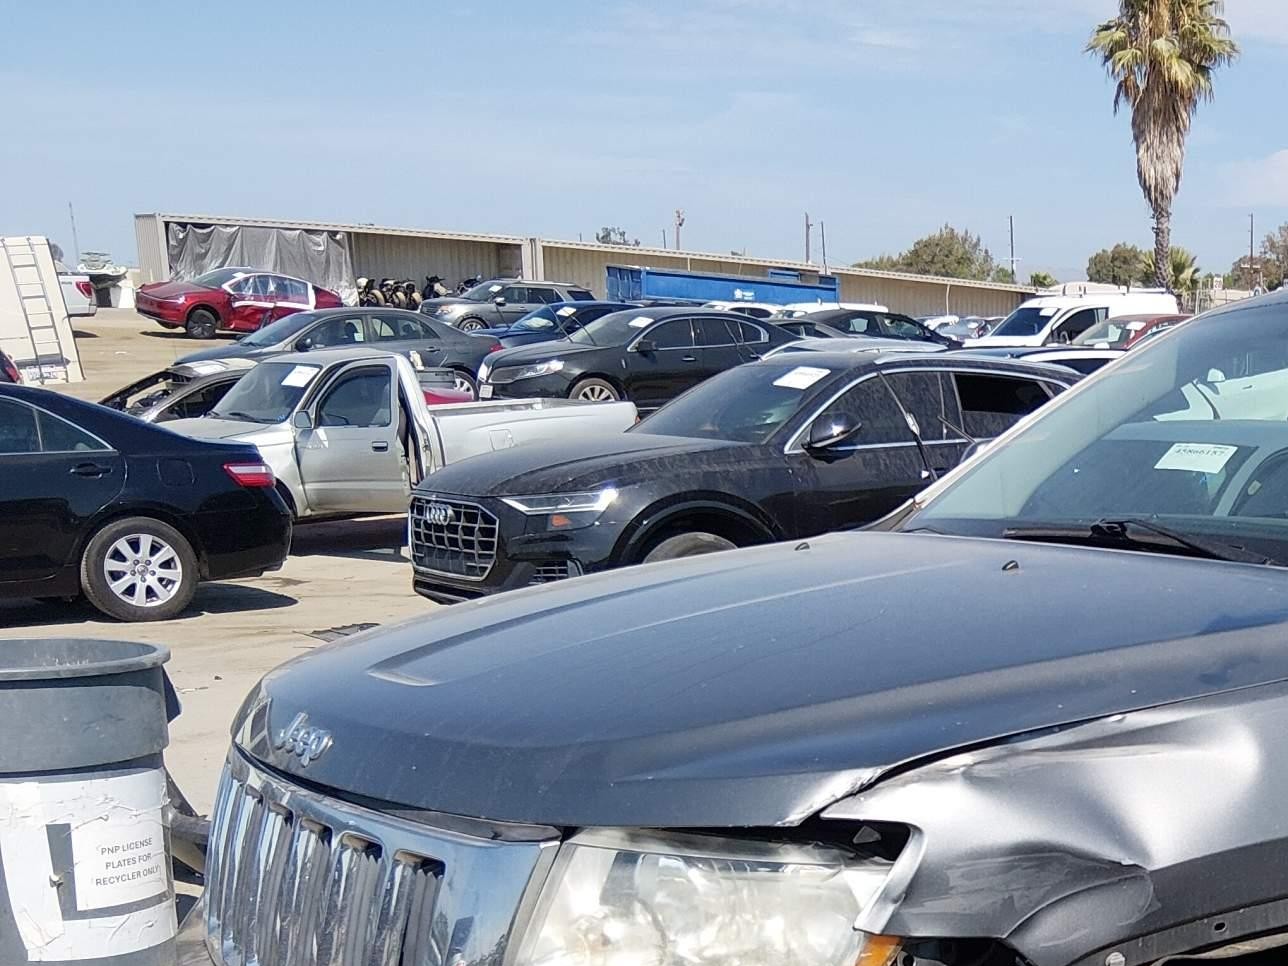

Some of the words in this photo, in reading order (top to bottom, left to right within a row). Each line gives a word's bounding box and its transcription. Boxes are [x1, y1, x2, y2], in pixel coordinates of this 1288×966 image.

[274, 712, 334, 769] Jeep
[100, 845, 121, 856] PNP
[122, 837, 153, 853] LICENSE
[105, 856, 137, 870] PLATES
[138, 852, 152, 863] FOR
[95, 870, 142, 887] RECYCLER
[142, 863, 160, 877] ONLY
